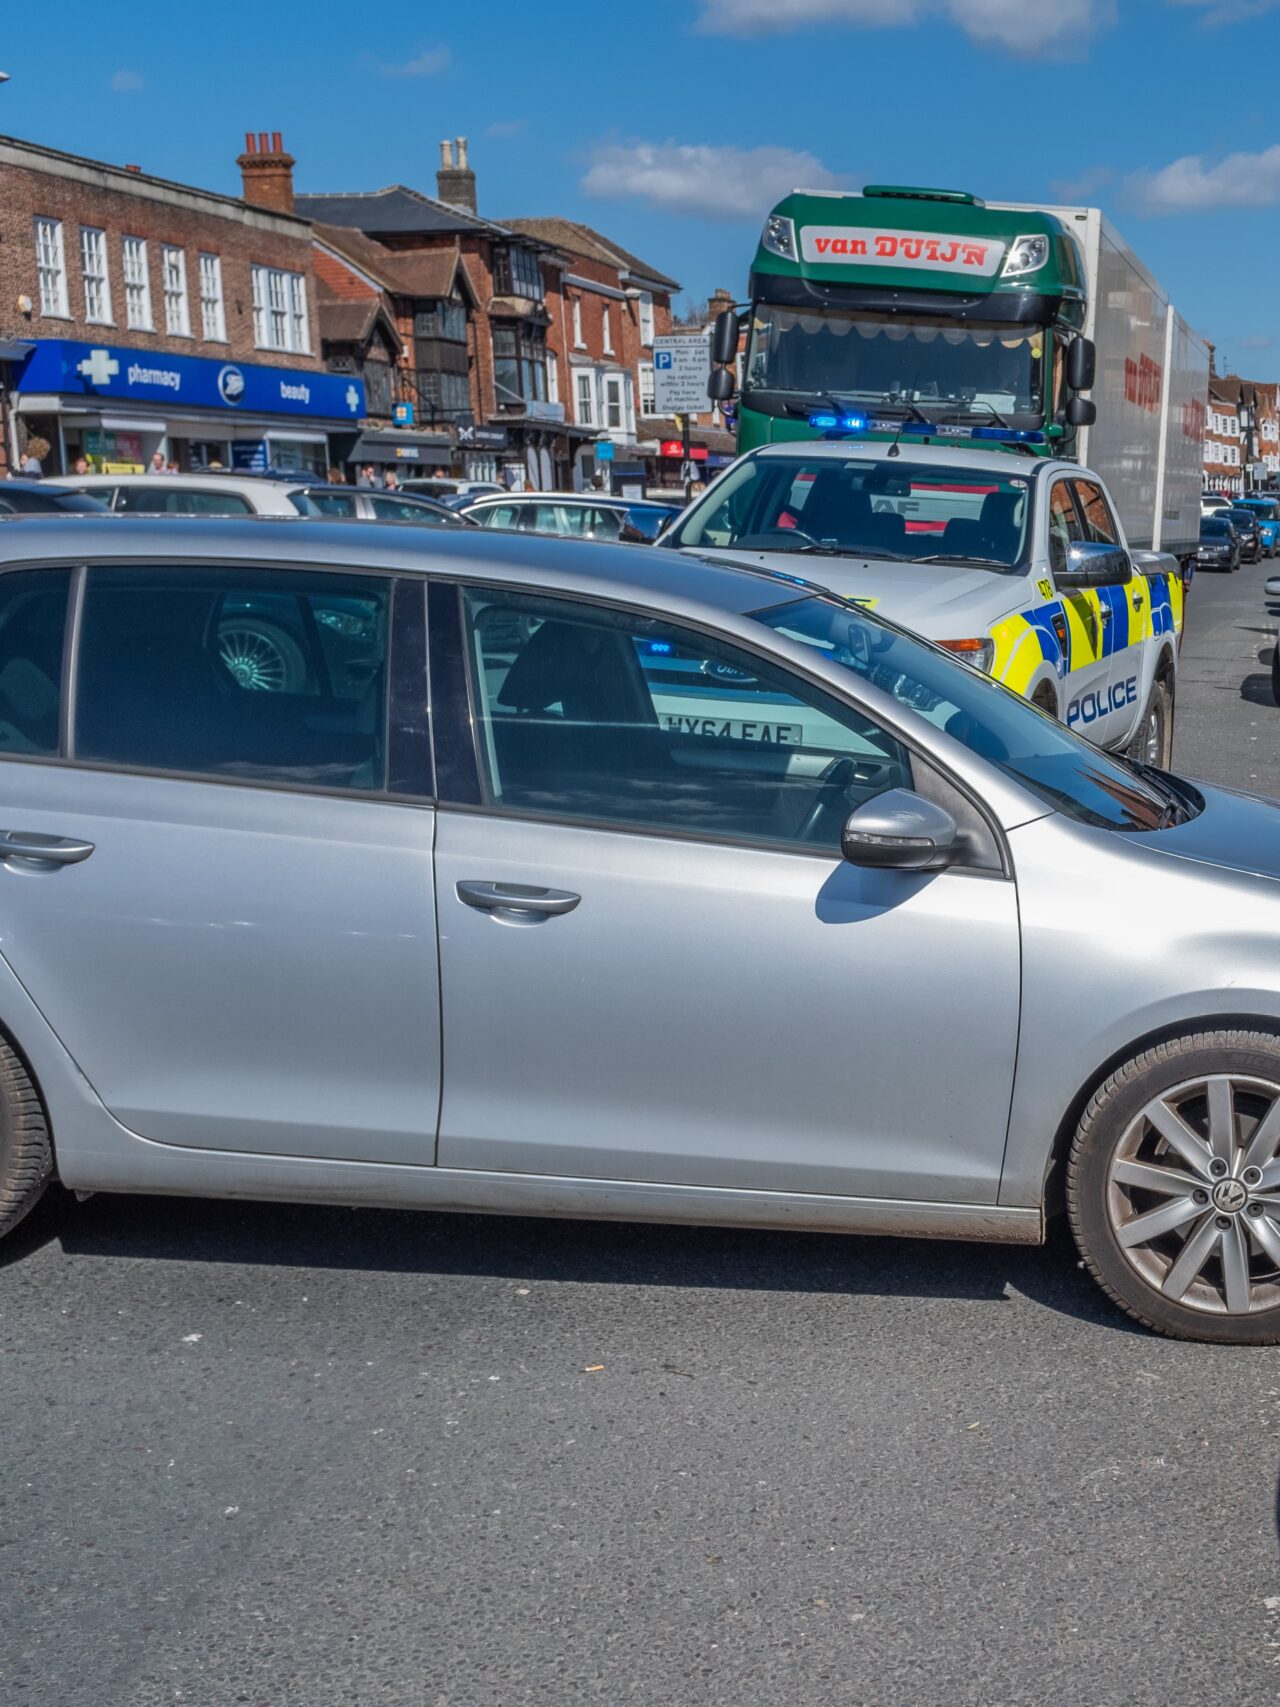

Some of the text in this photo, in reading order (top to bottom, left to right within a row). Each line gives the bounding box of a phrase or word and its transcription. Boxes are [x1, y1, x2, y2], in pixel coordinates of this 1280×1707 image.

[814, 235, 988, 266] van DUIJN
[655, 337, 686, 345] CENTRAL
[659, 353, 670, 369] P
[128, 363, 181, 391] pharmacy
[280, 380, 310, 404] beauty
[1066, 675, 1138, 728] POLICE
